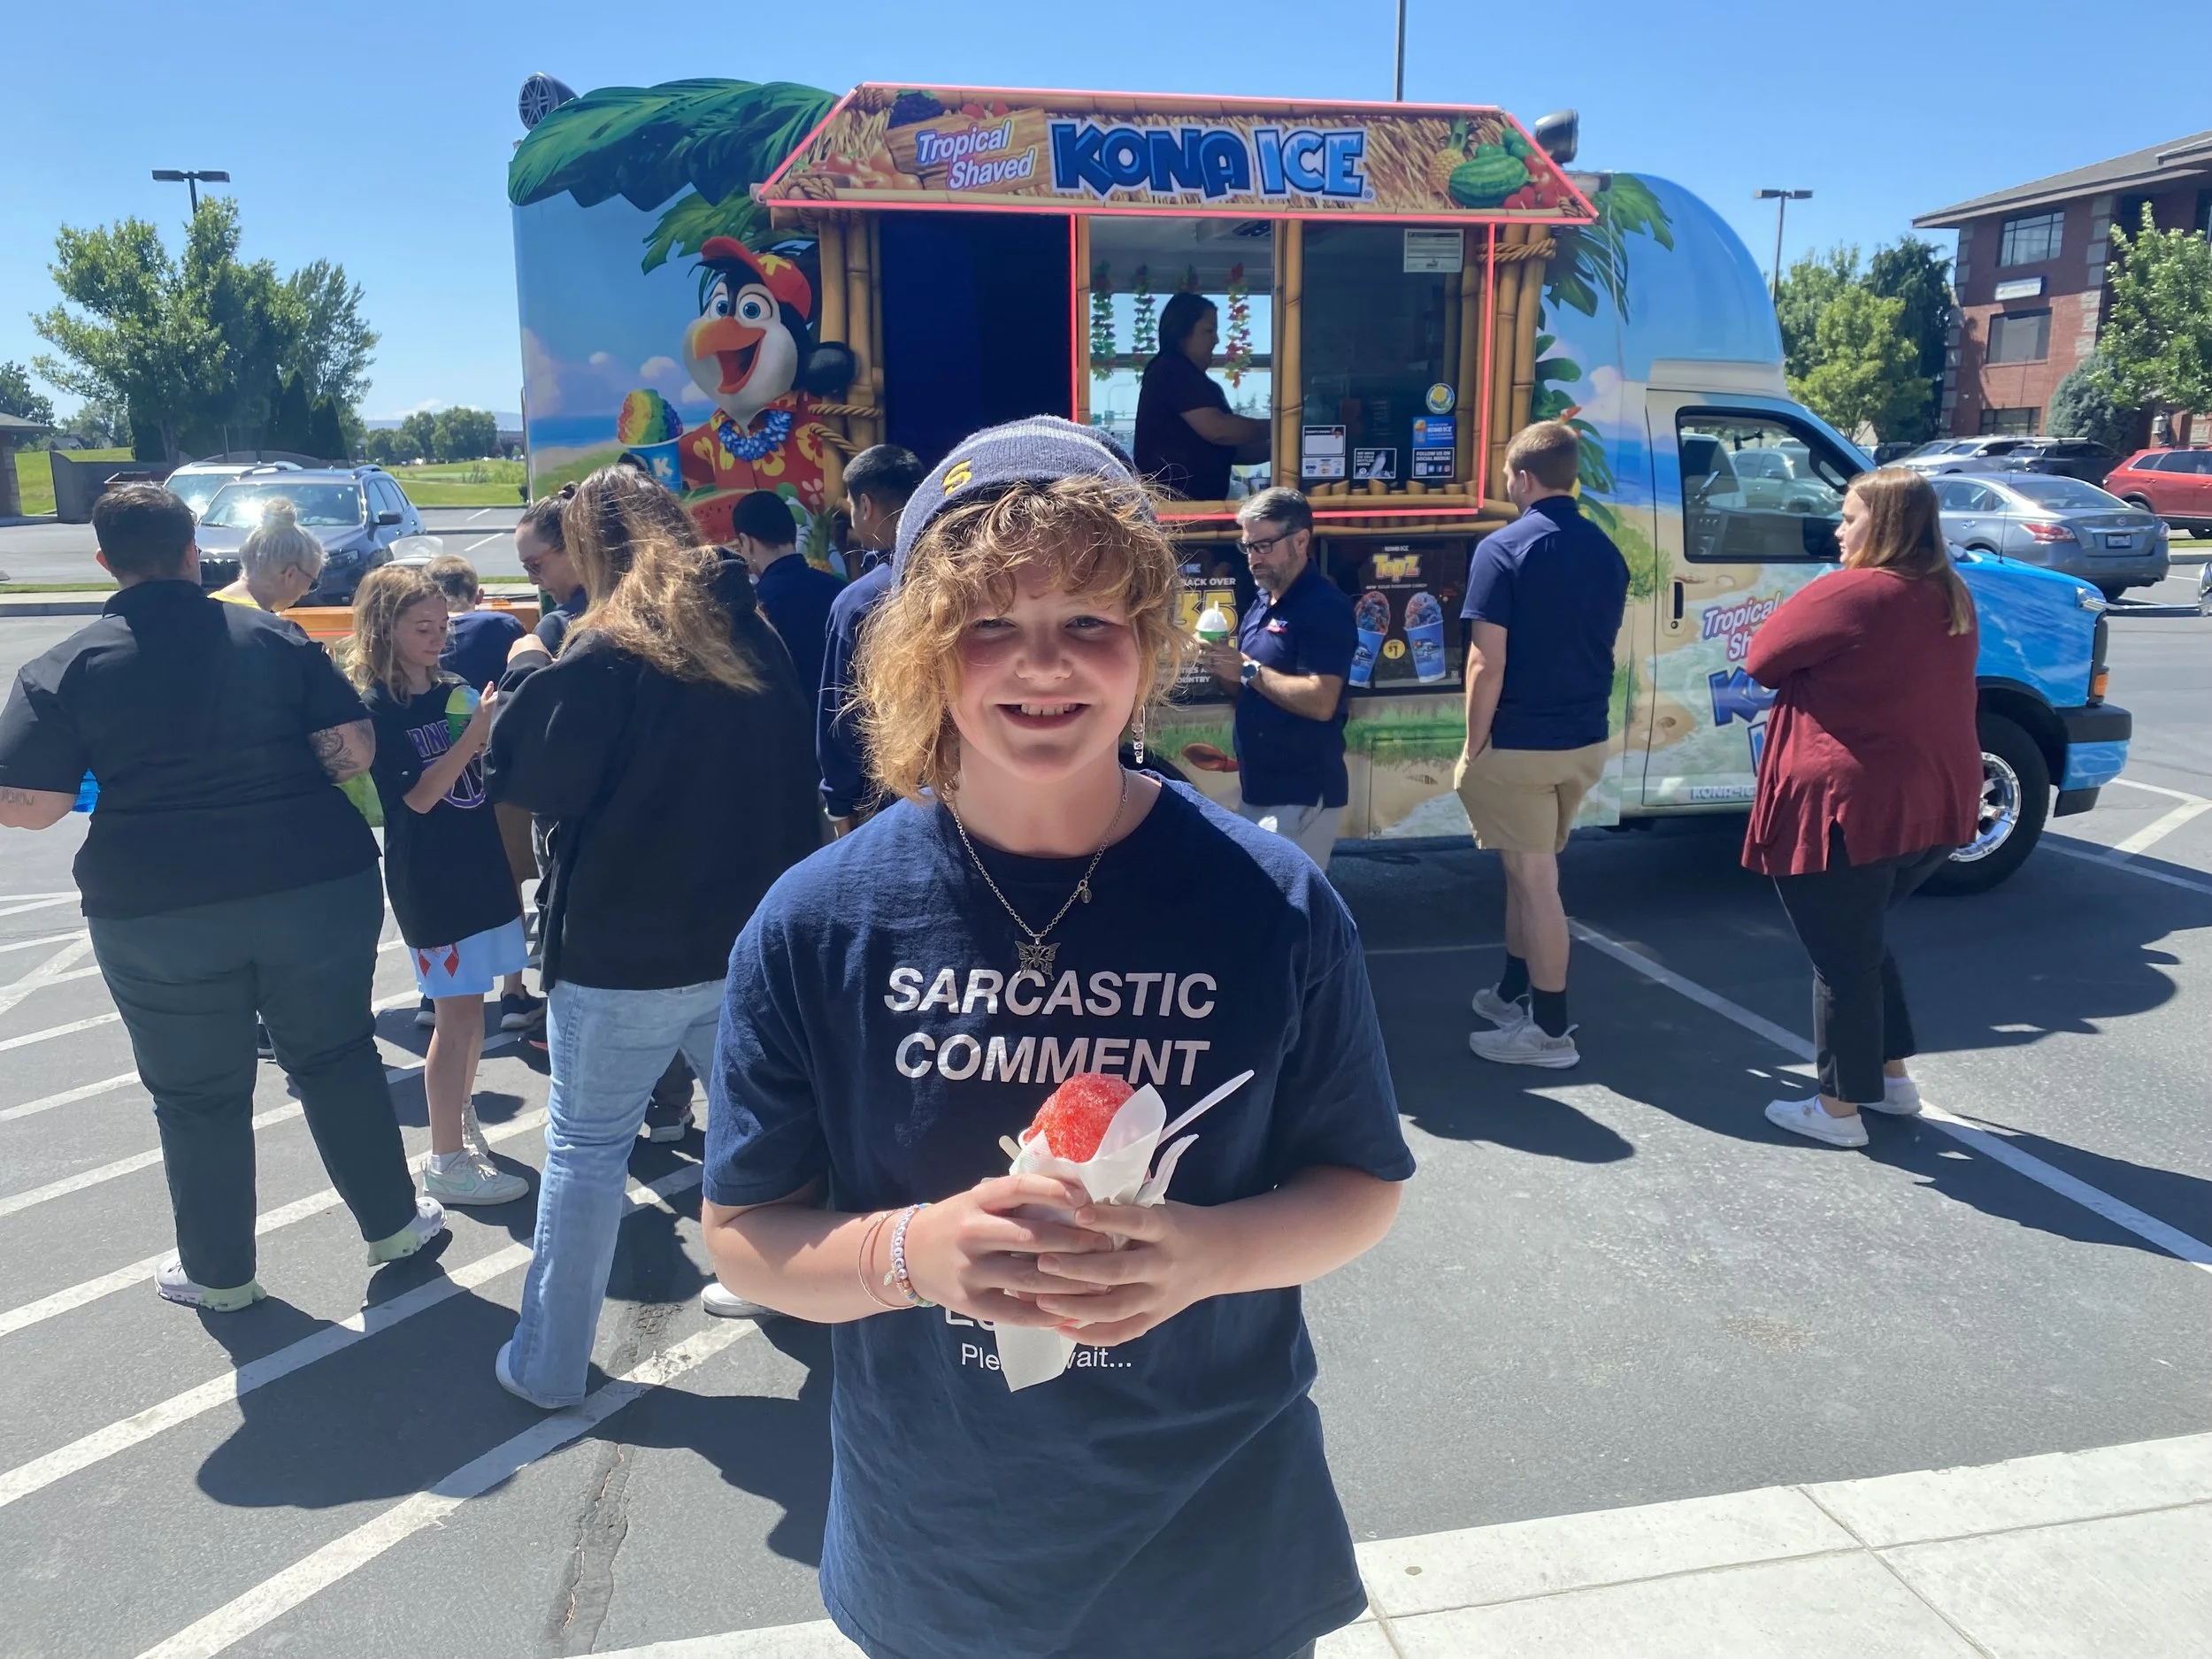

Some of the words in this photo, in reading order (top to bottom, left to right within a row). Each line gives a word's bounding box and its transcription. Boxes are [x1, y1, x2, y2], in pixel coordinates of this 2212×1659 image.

[918, 119, 1012, 163] Tropical
[1050, 122, 1252, 199] KONA
[1254, 128, 1366, 198] ICE
[948, 149, 1035, 189] Shaved
[652, 456, 673, 477] K
[1703, 590, 1782, 636] Tropical
[883, 967, 1218, 1019] SARCASTIC
[894, 1031, 1211, 1087] COMMENT
